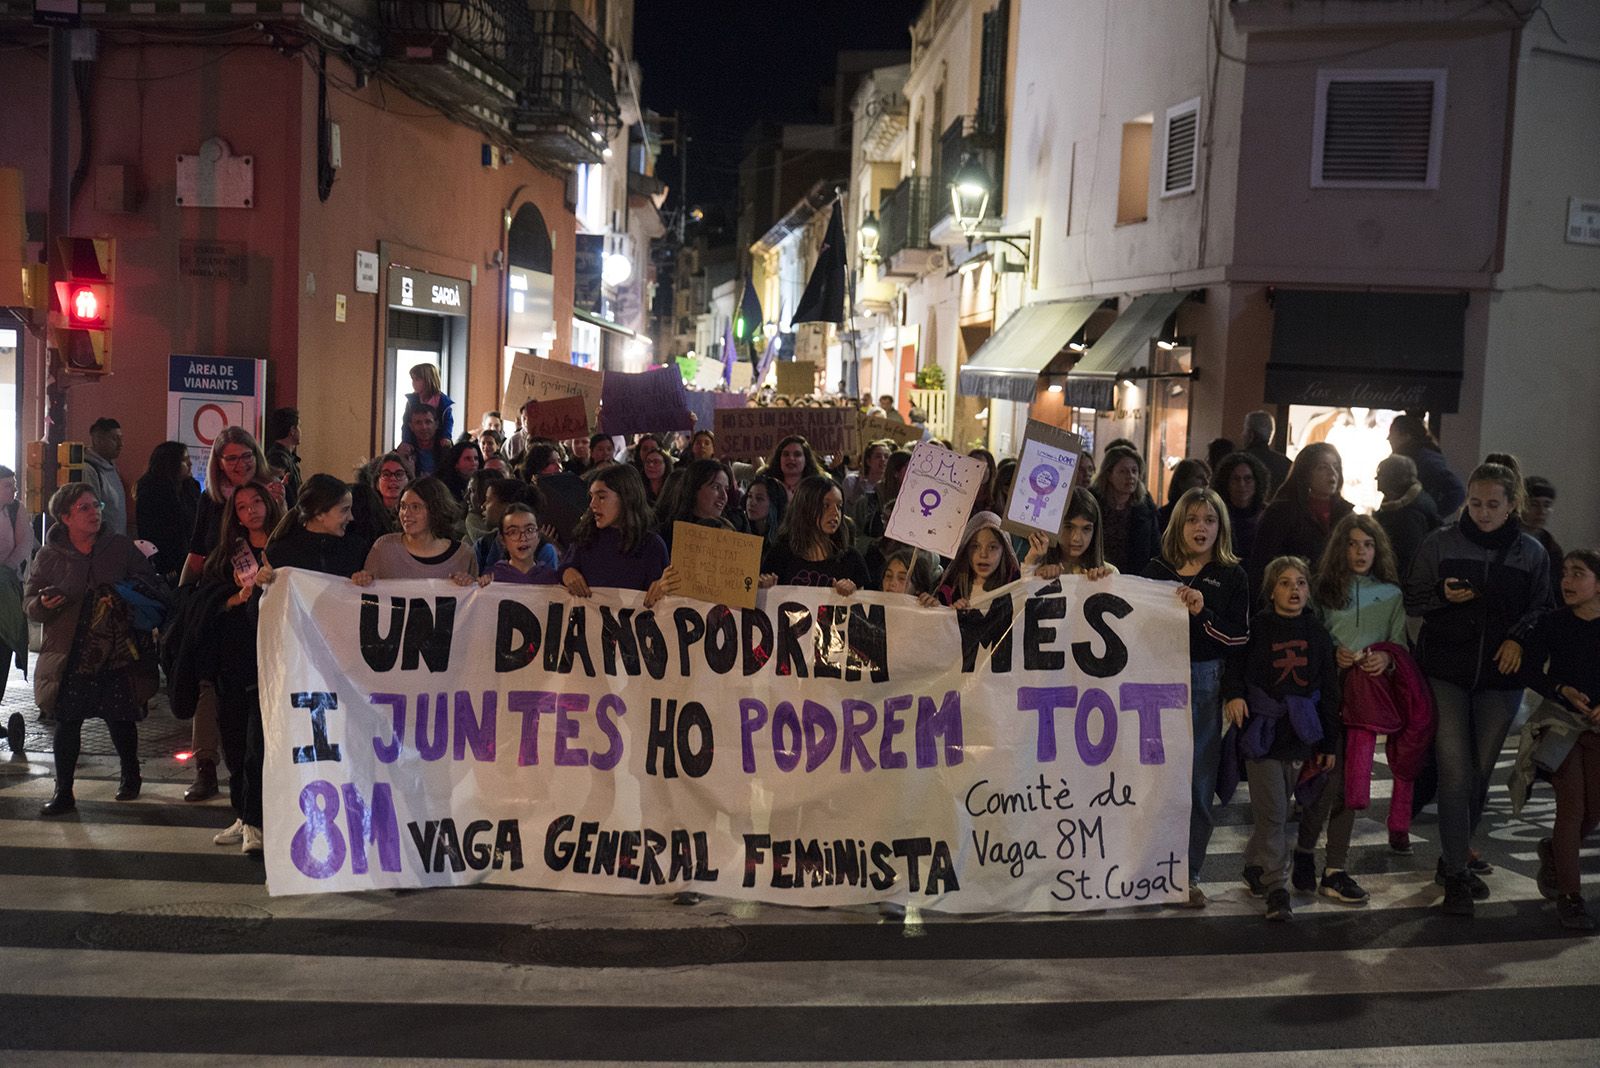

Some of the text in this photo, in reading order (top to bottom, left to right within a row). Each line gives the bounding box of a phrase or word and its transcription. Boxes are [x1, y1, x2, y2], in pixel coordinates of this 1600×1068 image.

[184, 377, 239, 391] VIANANTS
[188, 361, 234, 376] ÀREA DE
[759, 412, 776, 427] UN
[779, 411, 803, 427] CAS
[359, 579, 1134, 683] UN DIA NO PODREN MÉS
[290, 683, 1188, 778] I JUNTES HO PODREM TOT
[965, 772, 1136, 818] Comitè de
[290, 779, 402, 880] 8M
[407, 818, 524, 874] VAGA
[543, 814, 718, 885] GENERAL
[972, 816, 1106, 878] Vaga 8M
